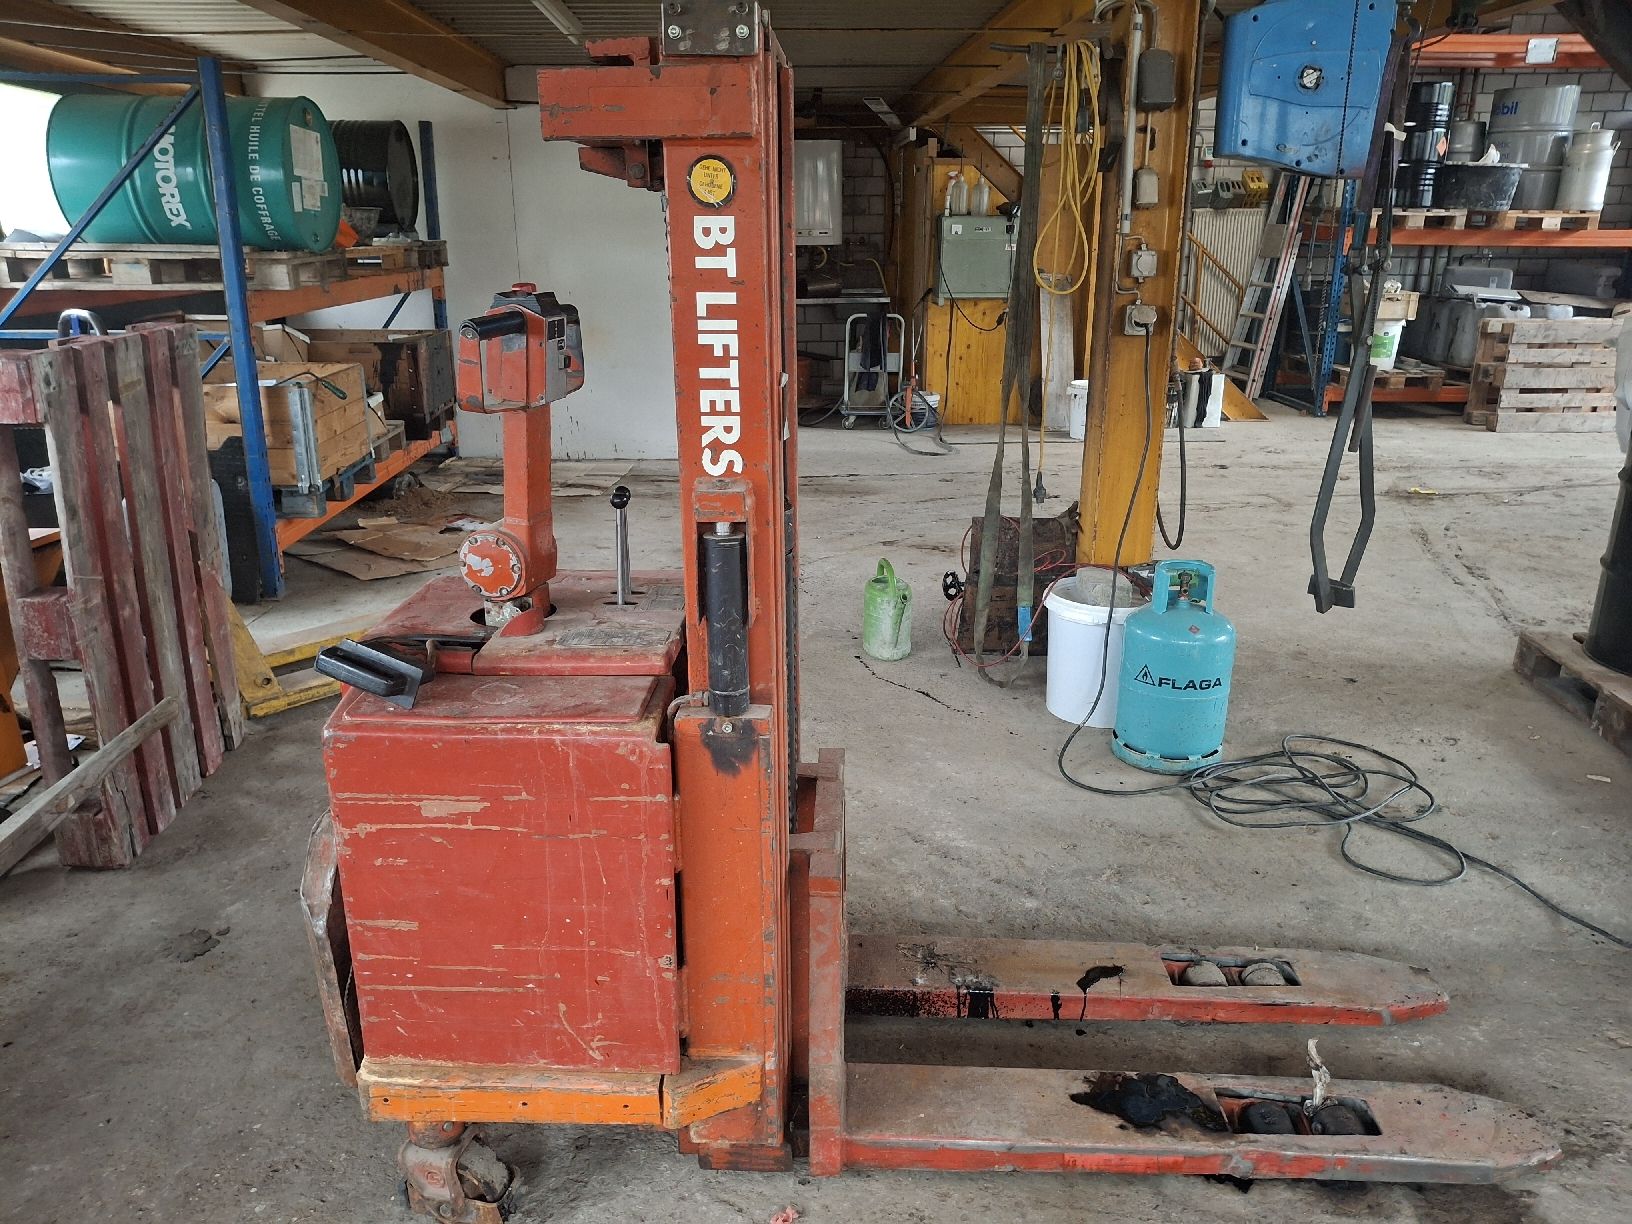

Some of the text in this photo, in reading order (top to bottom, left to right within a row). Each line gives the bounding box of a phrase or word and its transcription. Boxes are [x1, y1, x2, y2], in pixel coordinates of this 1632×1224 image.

[1495, 101, 1519, 116] obil
[248, 125, 261, 160] HUILE
[248, 165, 261, 182] DE
[252, 187, 281, 240] COFFRAGE
[693, 215, 743, 477] BT LIFTERS
[1157, 677, 1222, 691] FLAGA
